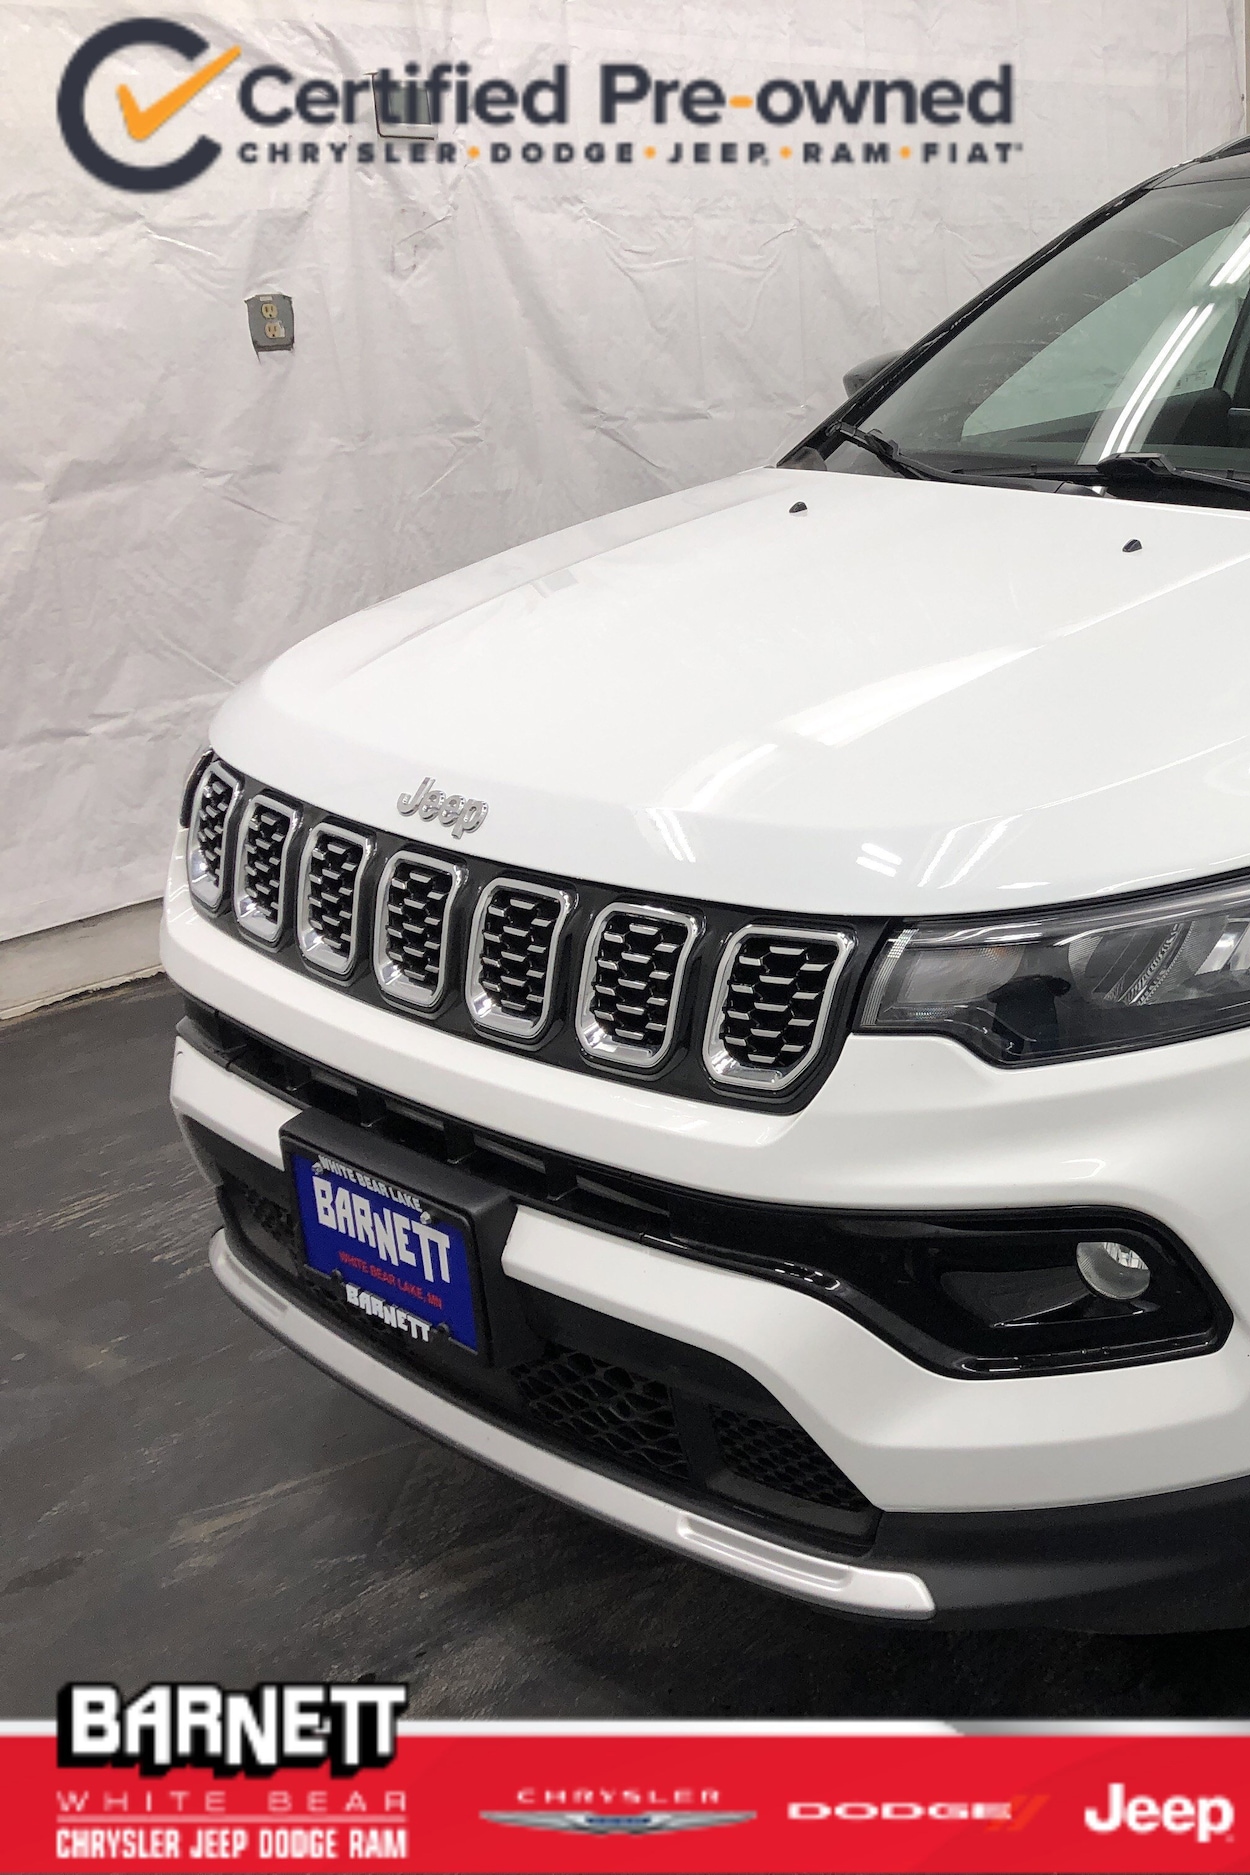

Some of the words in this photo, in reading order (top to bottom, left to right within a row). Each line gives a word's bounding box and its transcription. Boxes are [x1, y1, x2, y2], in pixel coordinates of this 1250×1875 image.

[397, 776, 489, 840] Jeep
[317, 1154, 357, 1183] WHITE
[356, 1171, 387, 1198] BEAR
[388, 1186, 423, 1212] LAKE
[312, 1175, 451, 1284] BARNETT
[337, 1250, 369, 1275] WHITE
[368, 1264, 397, 1287] BEAR
[344, 1282, 431, 1343] BARNETT
